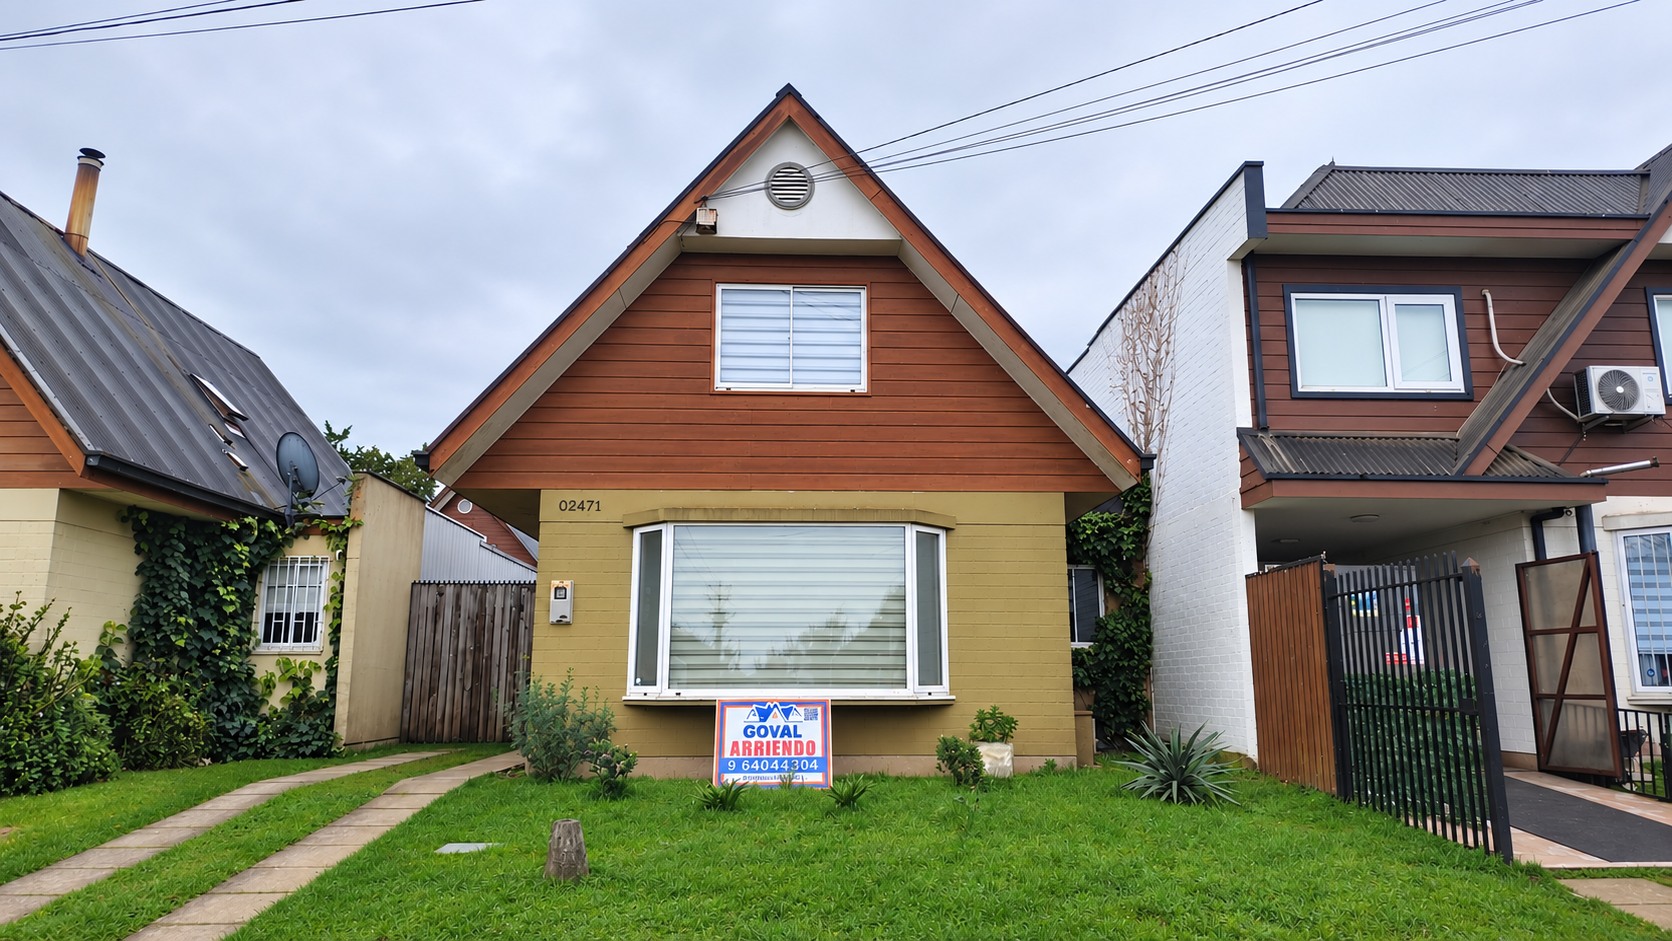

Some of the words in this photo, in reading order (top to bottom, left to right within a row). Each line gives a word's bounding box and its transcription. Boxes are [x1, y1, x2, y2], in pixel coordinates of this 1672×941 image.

[558, 499, 602, 512] 02471
[743, 724, 802, 738] GOVAL
[729, 740, 816, 757] ARRIENDO
[727, 759, 736, 771] 9
